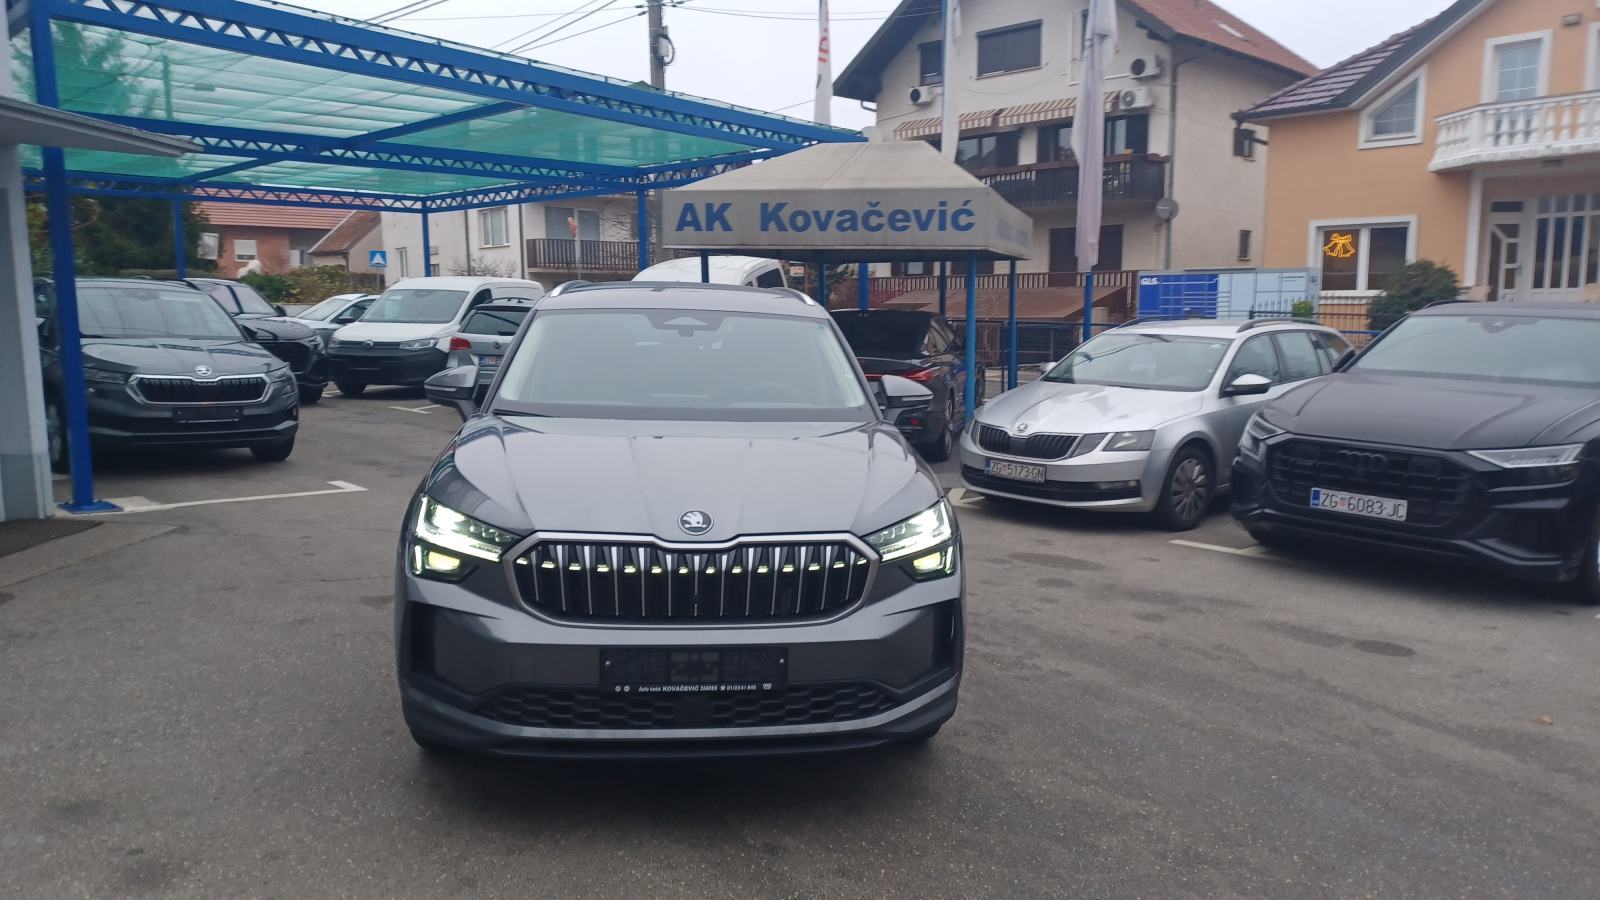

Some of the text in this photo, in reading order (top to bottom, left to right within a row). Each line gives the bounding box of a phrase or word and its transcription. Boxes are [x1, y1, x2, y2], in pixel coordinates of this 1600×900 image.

[675, 202, 733, 232] AK
[760, 200, 976, 233] Kovačević
[991, 461, 1002, 474] ZG
[1321, 492, 1338, 509] ZG
